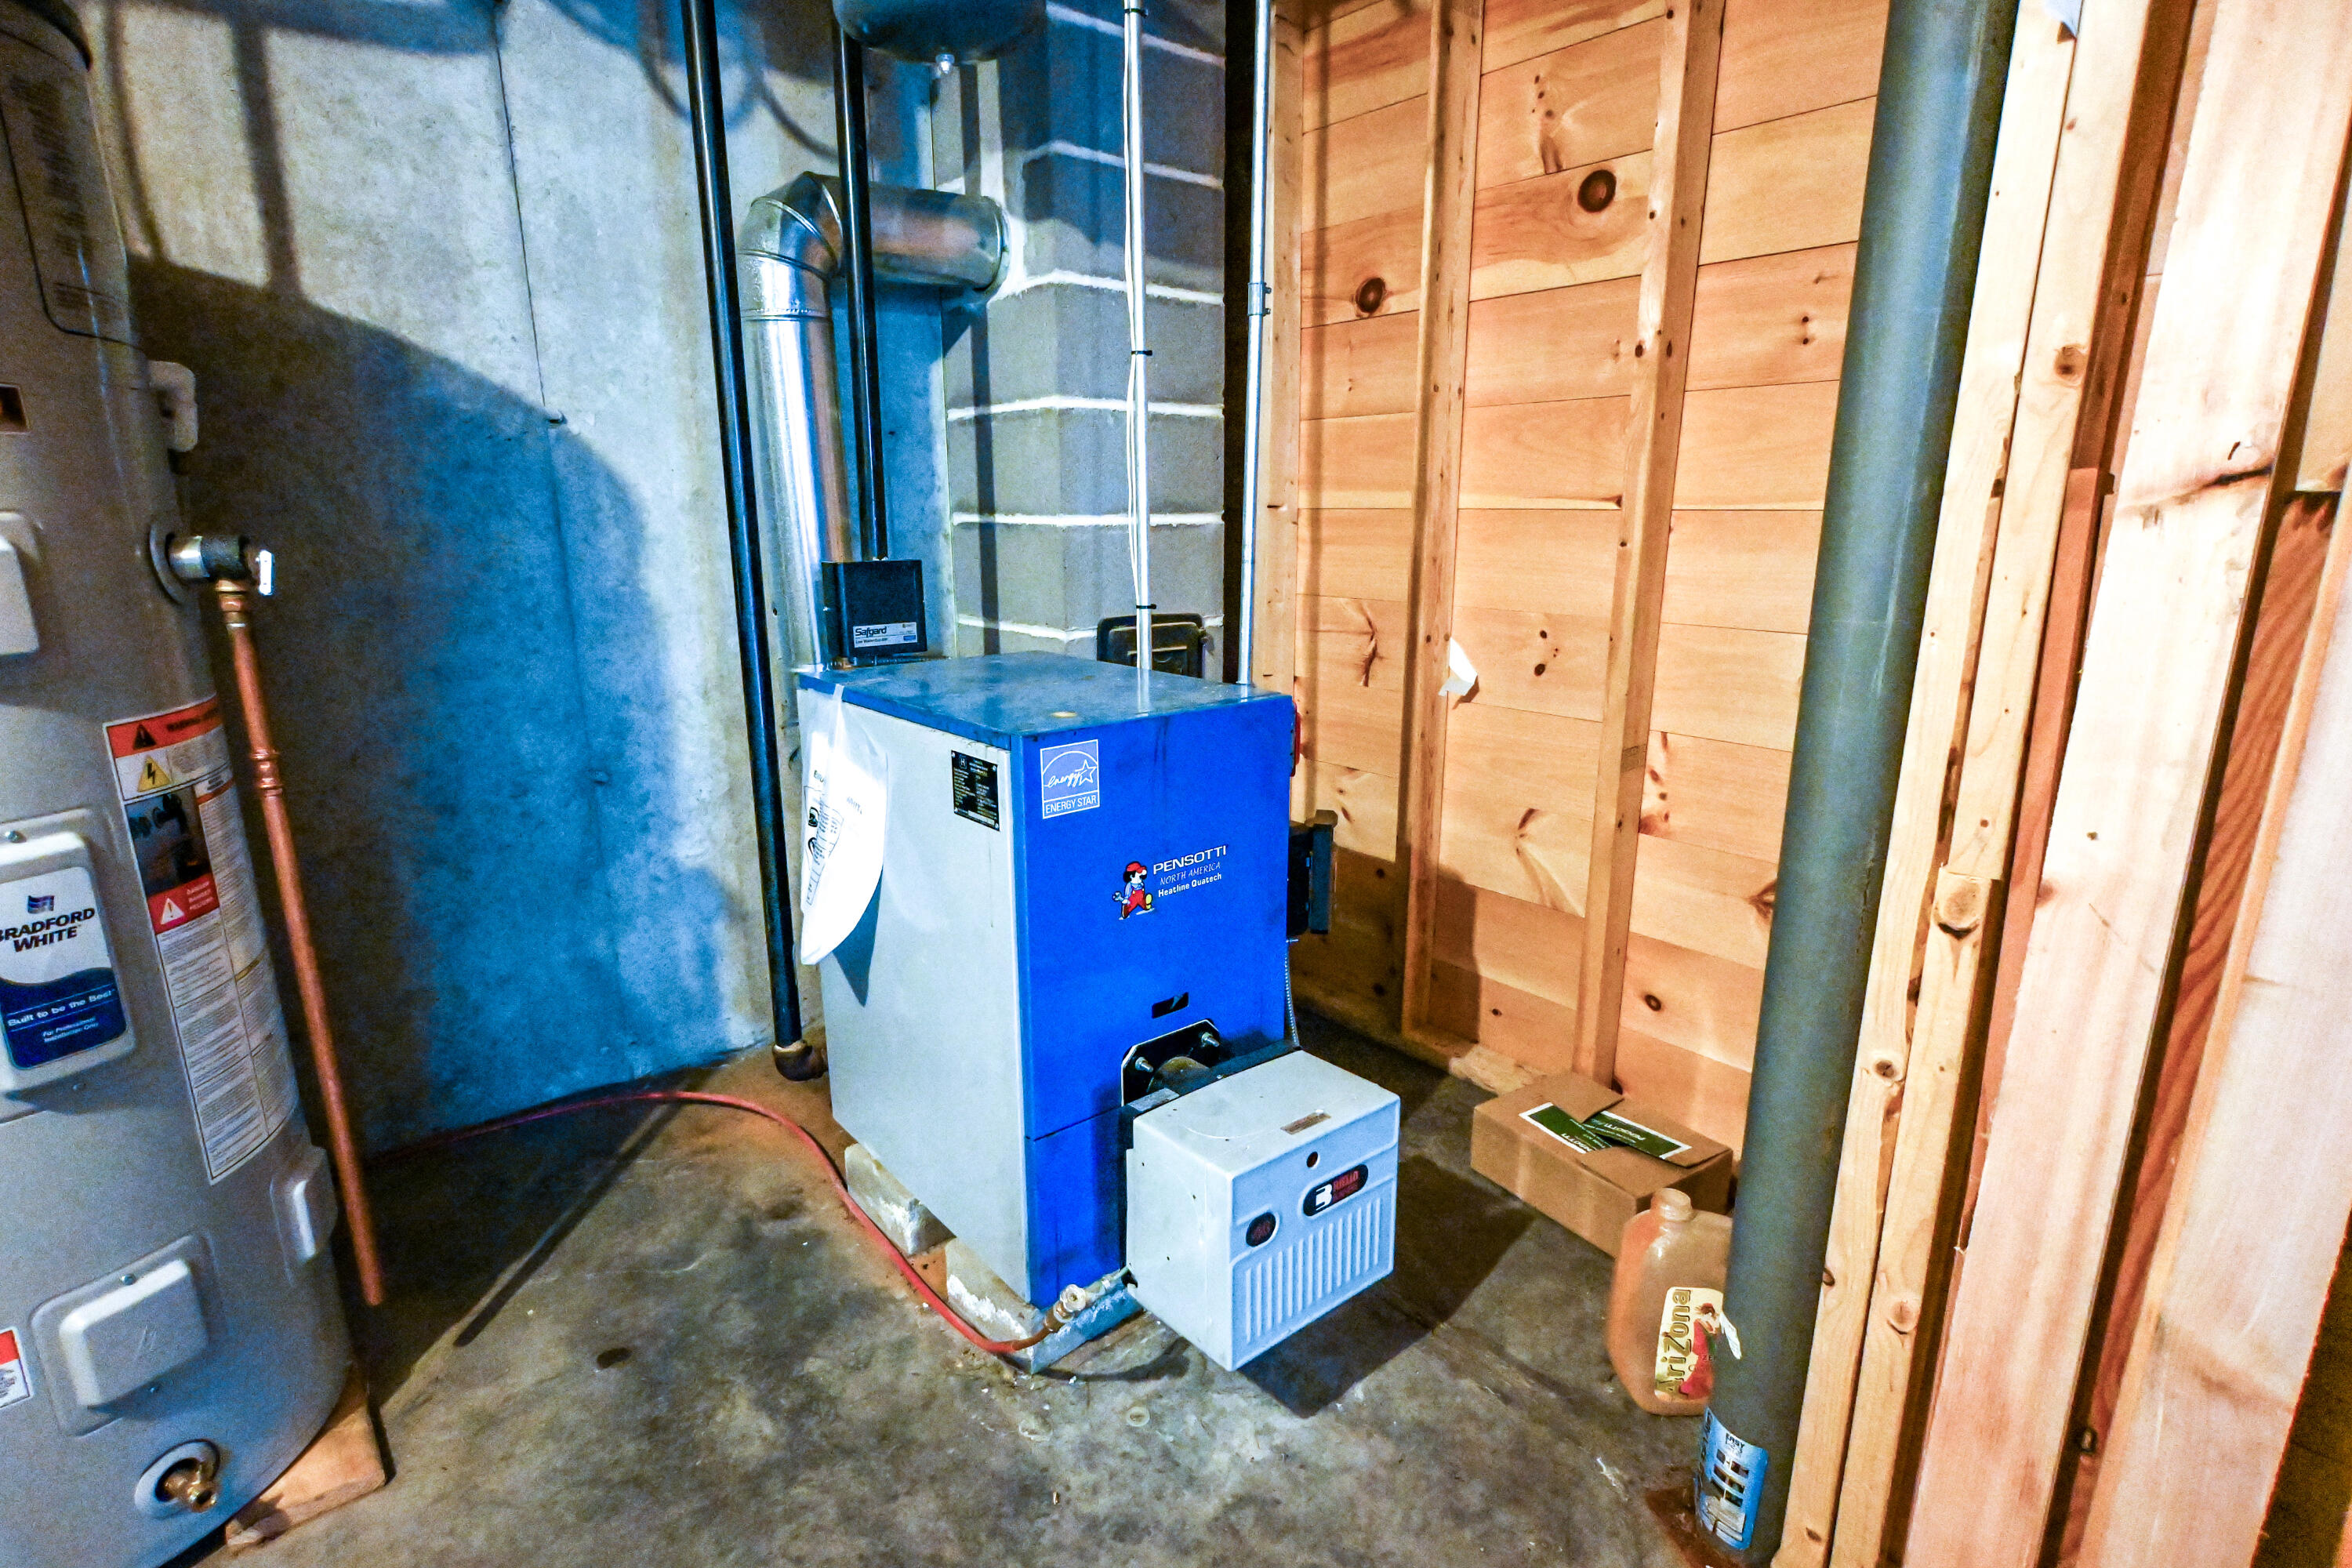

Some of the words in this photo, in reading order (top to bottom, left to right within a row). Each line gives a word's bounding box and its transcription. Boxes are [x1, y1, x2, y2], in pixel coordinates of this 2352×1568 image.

[855, 626, 887, 637] Safgard
[1045, 800, 1076, 815] ENERGY
[1077, 795, 1097, 808] STAR
[1152, 845, 1226, 875] PENSOTTI
[1158, 883, 1190, 898] Heatline
[1191, 872, 1222, 887] Quatech
[1160, 870, 1186, 885] NORTH
[1188, 861, 1221, 877] AMERICA
[14, 926, 78, 953] WHITE
